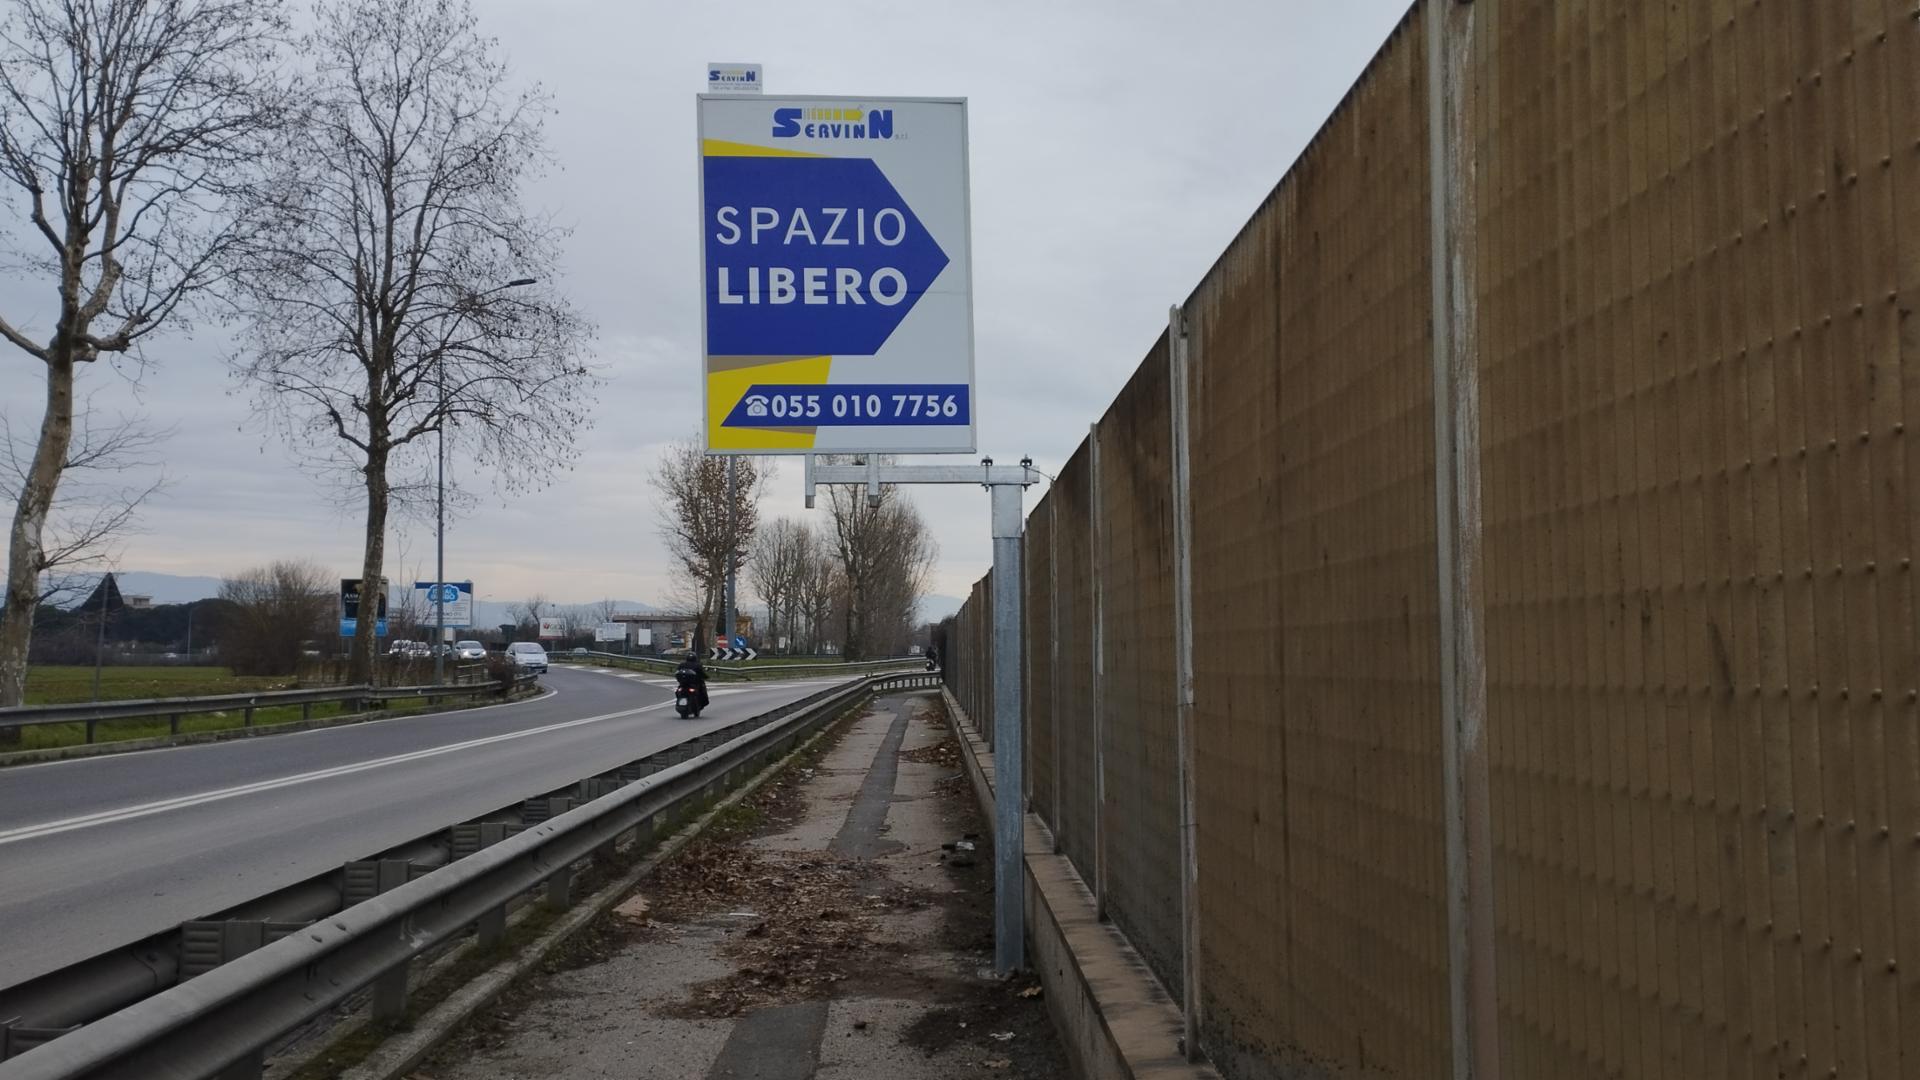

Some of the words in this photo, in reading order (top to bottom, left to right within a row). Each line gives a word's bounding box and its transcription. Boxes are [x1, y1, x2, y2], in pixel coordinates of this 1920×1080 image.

[716, 206, 906, 246] SPAZIO
[718, 267, 908, 306] LIBERO
[771, 394, 821, 417] 055
[832, 394, 881, 417] 010
[892, 394, 958, 417] 7756
